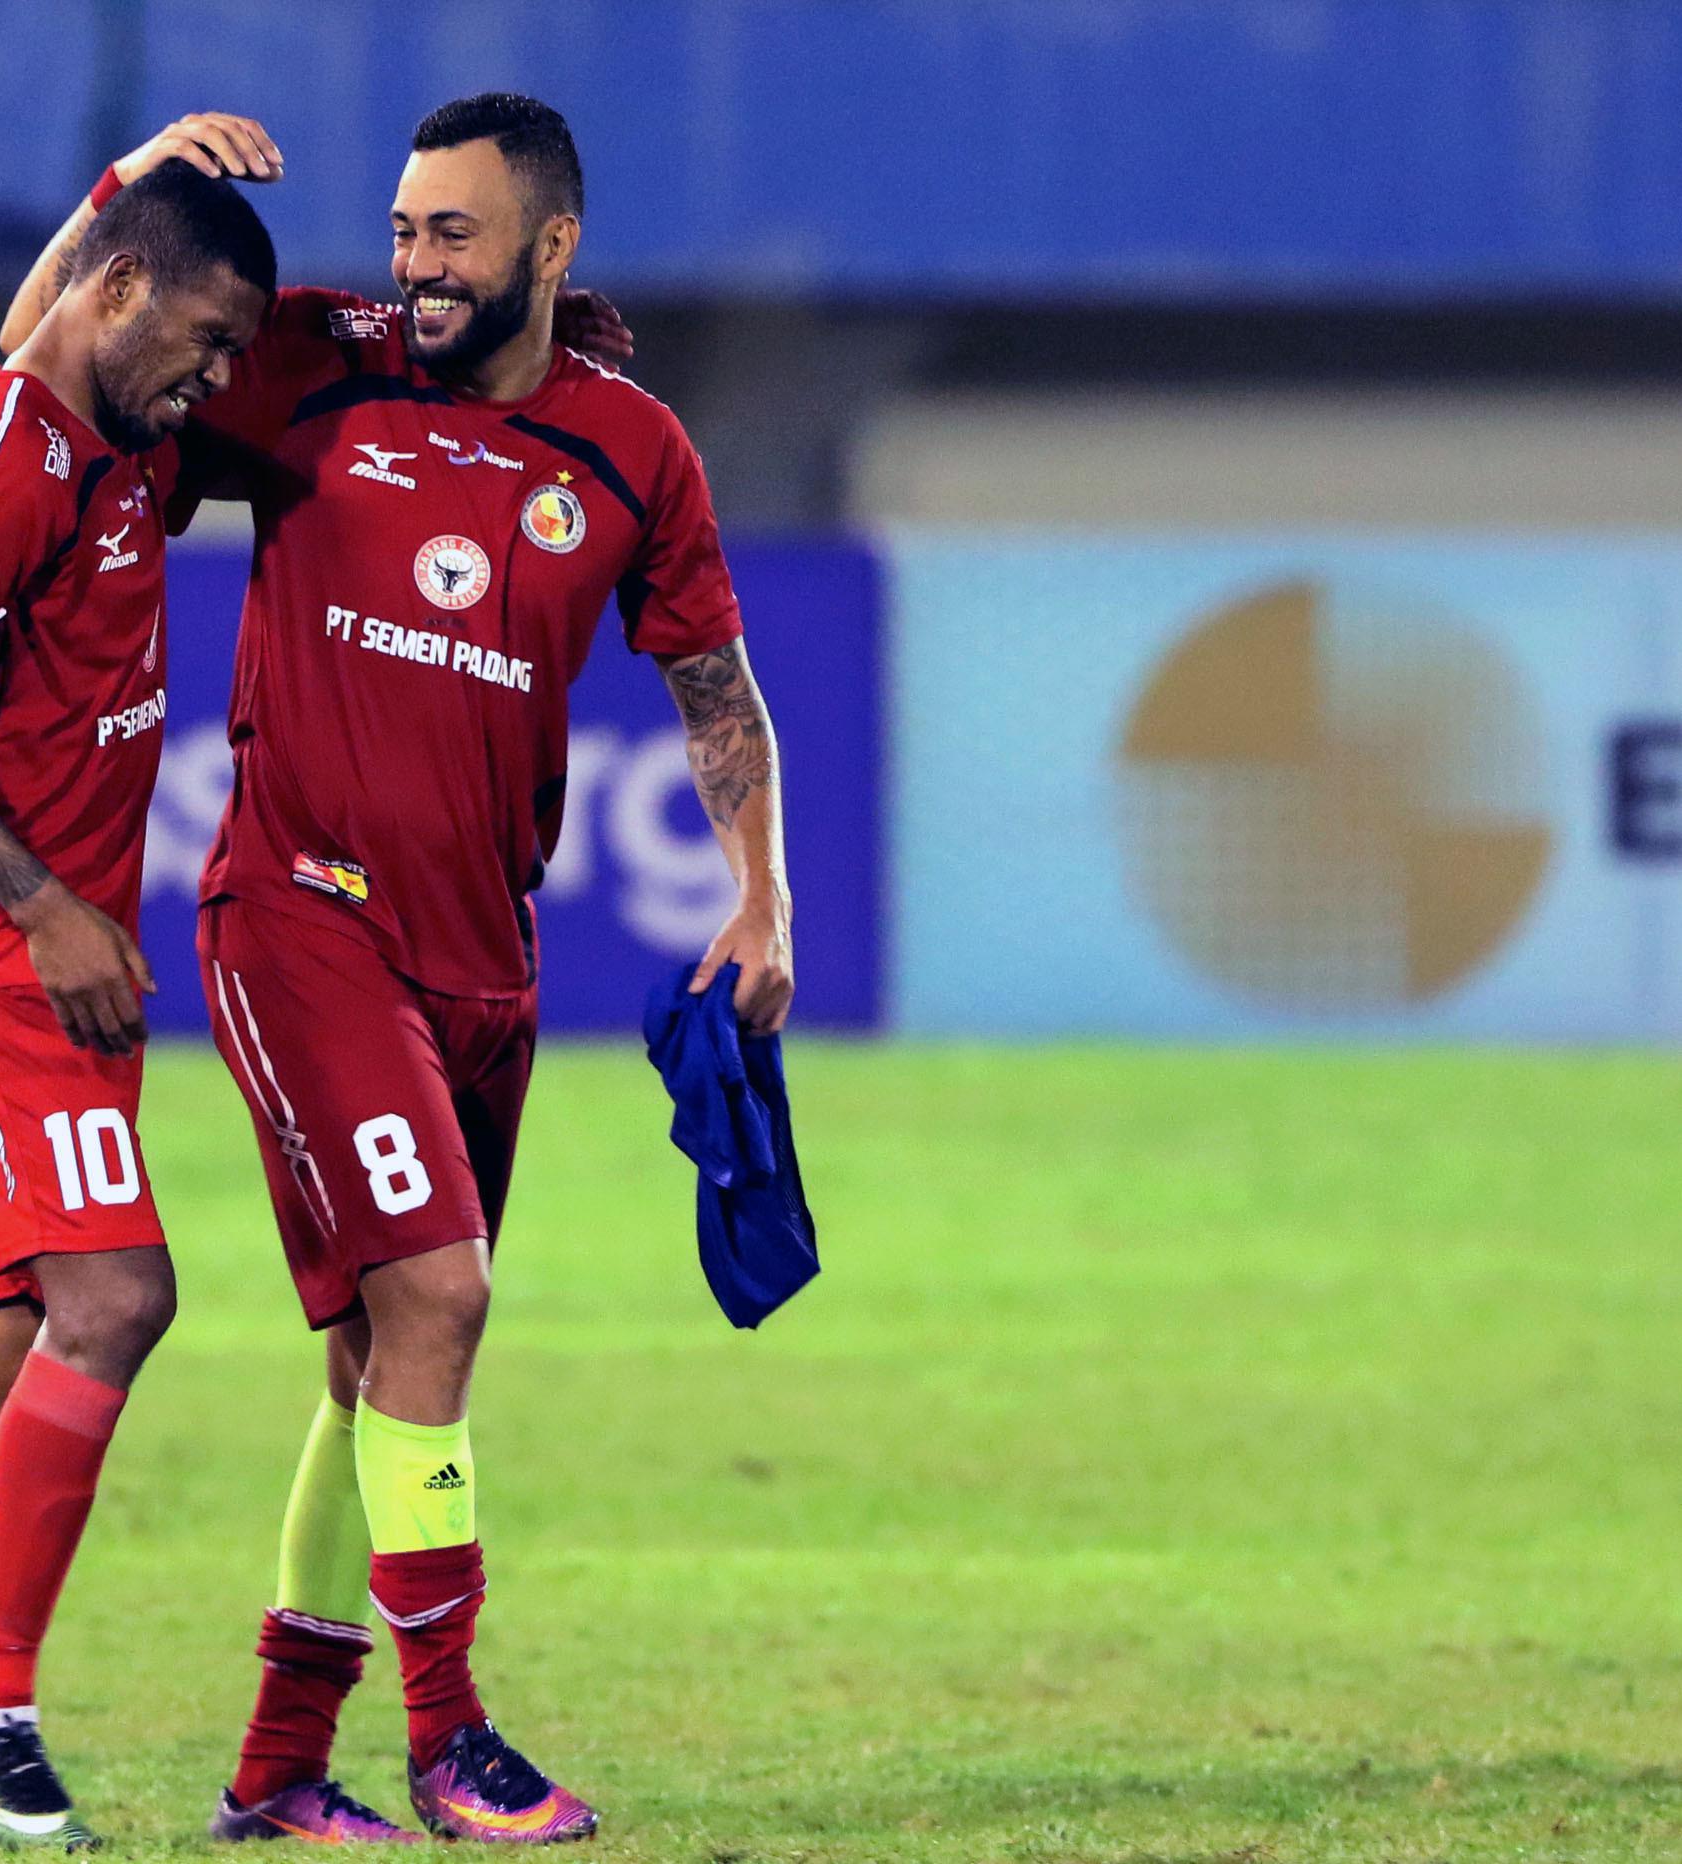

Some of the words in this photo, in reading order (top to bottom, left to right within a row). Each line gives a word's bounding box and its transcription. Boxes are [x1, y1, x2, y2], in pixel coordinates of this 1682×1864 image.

[427, 431, 462, 452] Bank
[482, 449, 524, 472] Nagari
[326, 605, 358, 642] PT
[360, 617, 449, 666] SEMEN
[452, 640, 533, 693] PADANG
[43, 1107, 141, 1210] 10
[352, 1113, 434, 1216] 8
